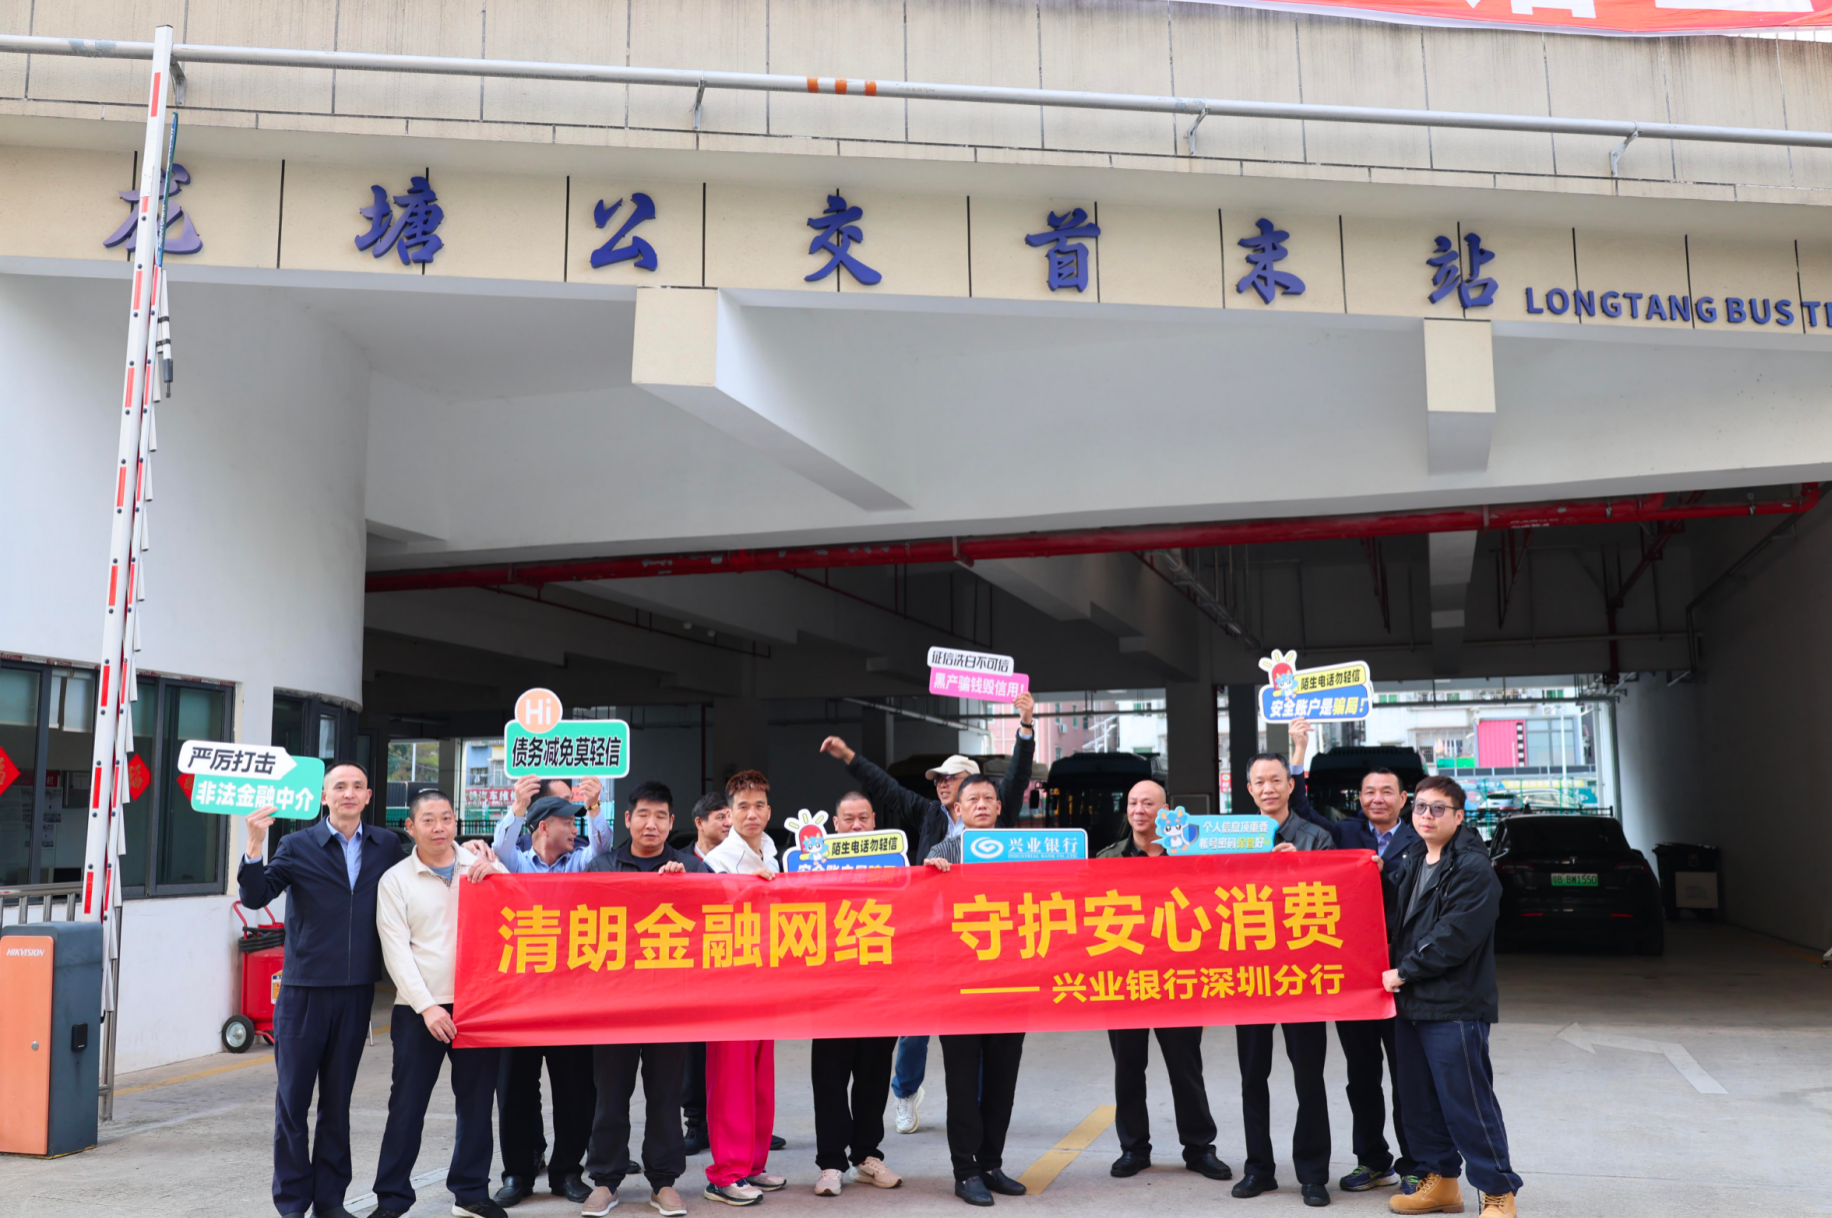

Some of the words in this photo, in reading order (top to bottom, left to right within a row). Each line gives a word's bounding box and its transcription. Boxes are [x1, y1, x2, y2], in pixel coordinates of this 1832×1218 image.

[1525, 286, 1718, 323] LONGTANG
[1725, 297, 1795, 326] BUS
[931, 650, 1010, 673] 征信洗白不可信
[1301, 669, 1361, 691] 陌生电话勿轻信
[525, 698, 551, 725] Hi
[1269, 697, 1366, 718] 安全账户是骗局!
[187, 746, 277, 775] 严厉打击
[511, 736, 622, 768] 债务减免莫轻信
[195, 780, 315, 812] 非法金融中介
[1202, 821, 1269, 833] 个人信息顶重要
[831, 836, 899, 856] 陌生电话勿轻信
[1008, 837, 1078, 853] 兴业银行
[952, 881, 1344, 961] 守护安心消费
[498, 899, 896, 974] 清朗金融网络
[6, 948, 45, 957] HIKVISION
